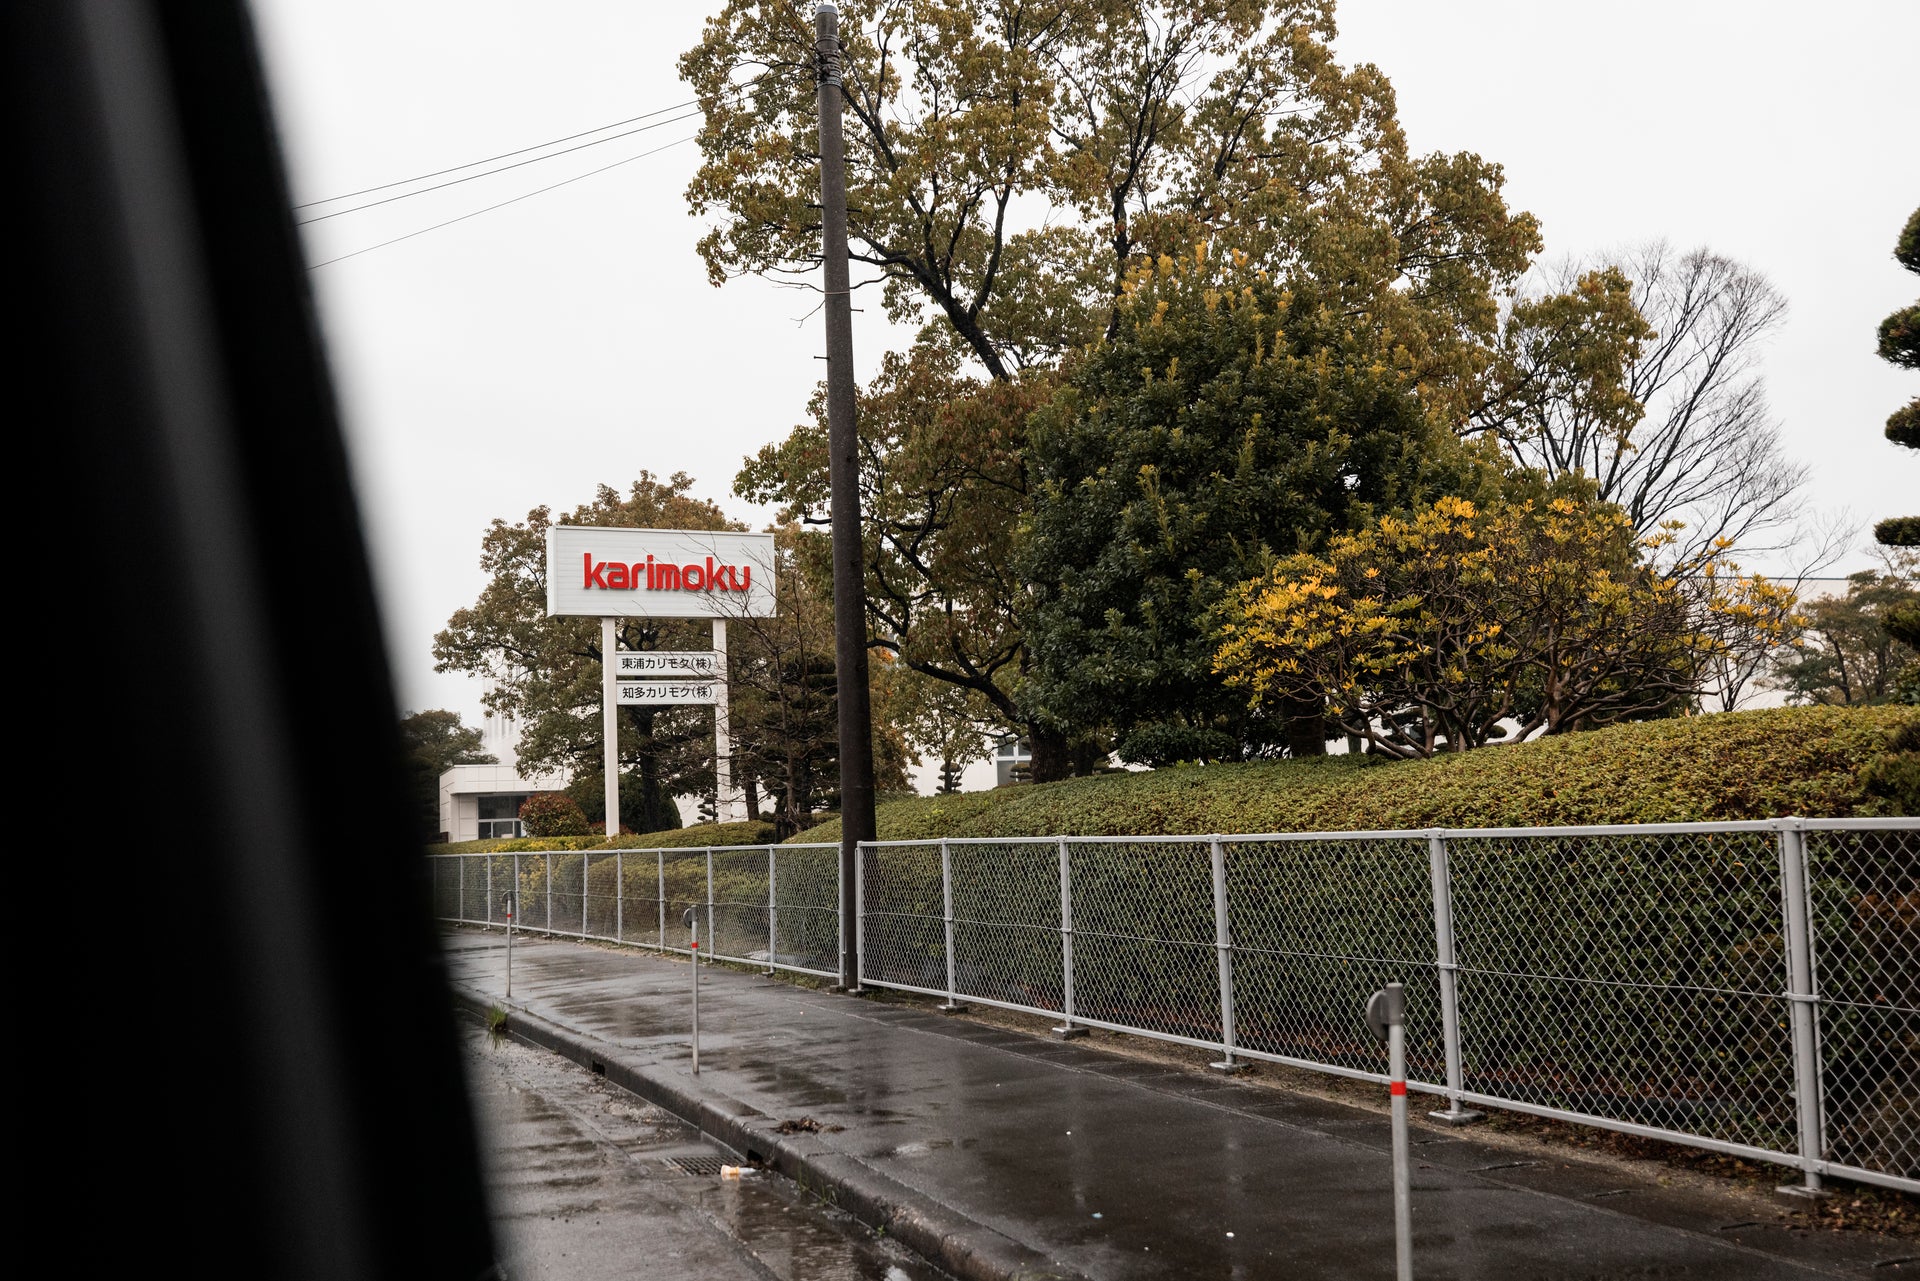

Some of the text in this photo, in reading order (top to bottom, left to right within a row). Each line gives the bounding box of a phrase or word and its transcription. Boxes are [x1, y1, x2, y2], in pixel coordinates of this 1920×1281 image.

[583, 552, 751, 591] karimoku
[622, 687, 713, 699] 知多カリモク(株)
